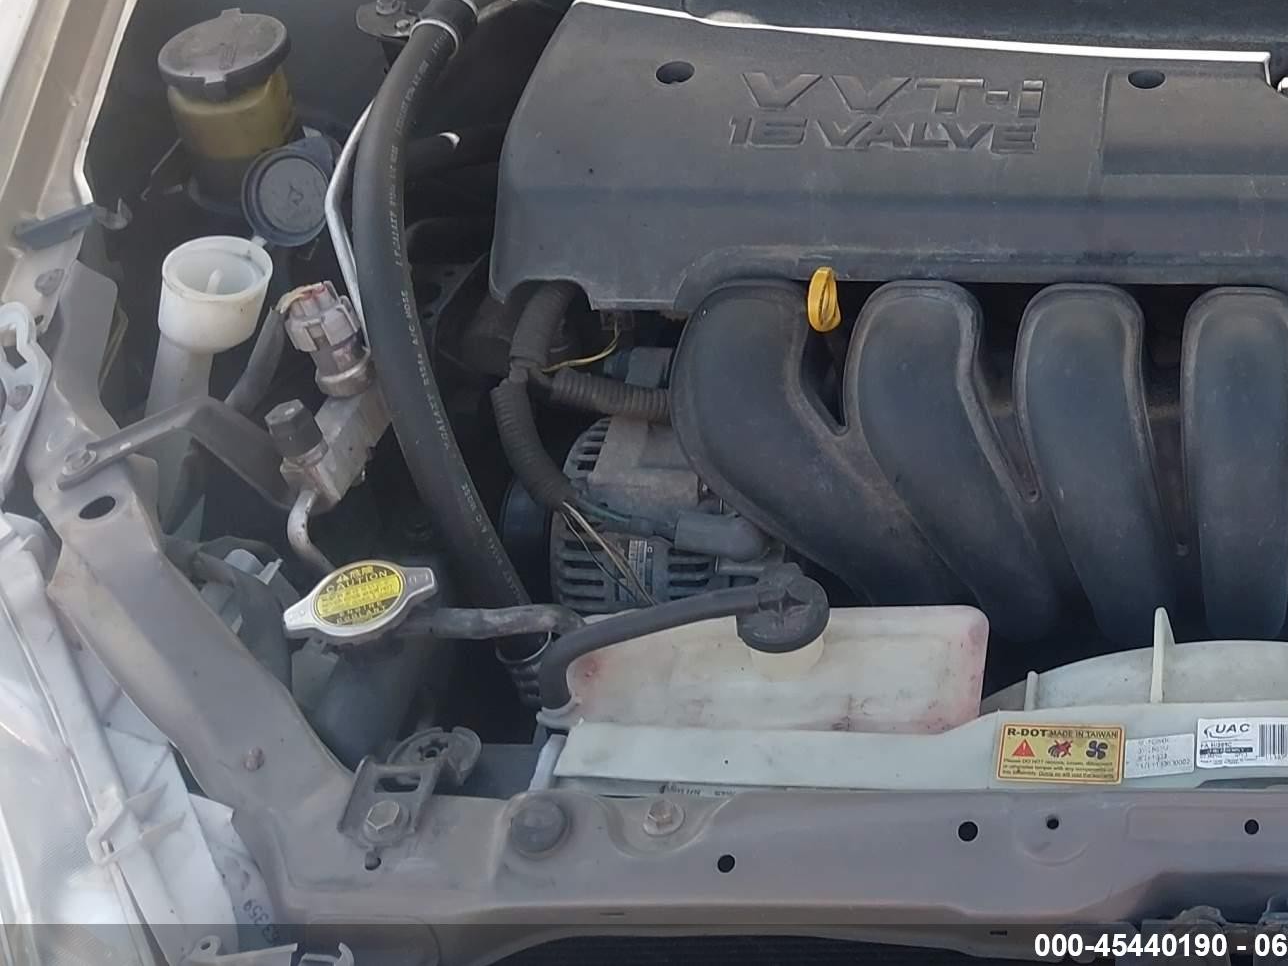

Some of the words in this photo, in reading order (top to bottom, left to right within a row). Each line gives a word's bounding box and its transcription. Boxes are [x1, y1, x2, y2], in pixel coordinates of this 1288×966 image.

[742, 72, 1046, 117] VVT-i
[1007, 728, 1048, 737] R-DOT
[1049, 729, 1071, 738] MADE
[1074, 730, 1084, 738] IN
[1086, 731, 1119, 739] TAIWAN
[1215, 723, 1251, 734] UAC
